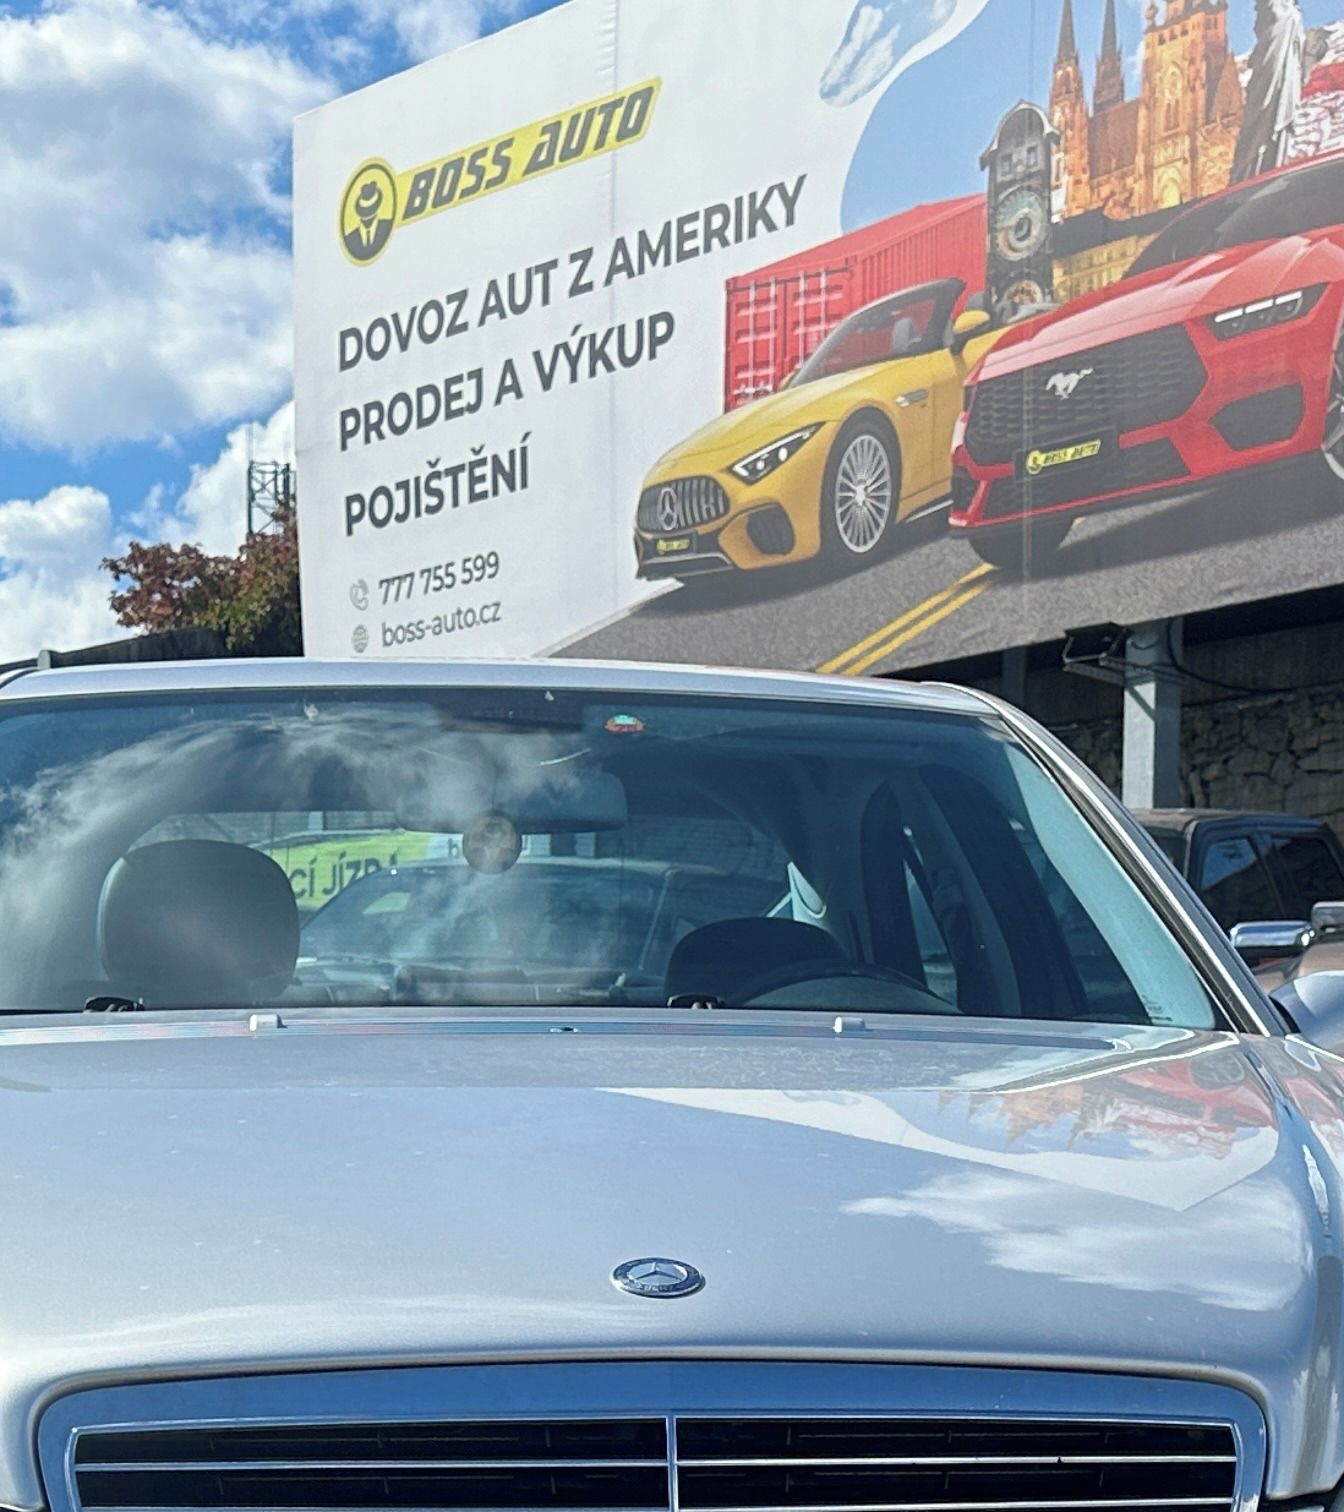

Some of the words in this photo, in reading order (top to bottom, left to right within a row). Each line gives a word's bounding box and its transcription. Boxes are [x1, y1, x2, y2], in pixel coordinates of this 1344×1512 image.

[402, 137, 514, 221] BOSS
[522, 86, 654, 176] AUTO
[338, 288, 468, 372] DOVOZ
[478, 259, 558, 327] AUT
[568, 247, 594, 298] Z
[603, 174, 807, 288] AMERIKY
[339, 368, 483, 451] PRODEJ
[494, 358, 523, 408] A
[533, 311, 674, 391] VÝKUP
[345, 432, 532, 537] POJIŠTĚNÍ
[379, 572, 414, 605] 777
[420, 562, 456, 595] 755
[462, 551, 499, 584] 599
[382, 601, 501, 647] boss-auto.cz
